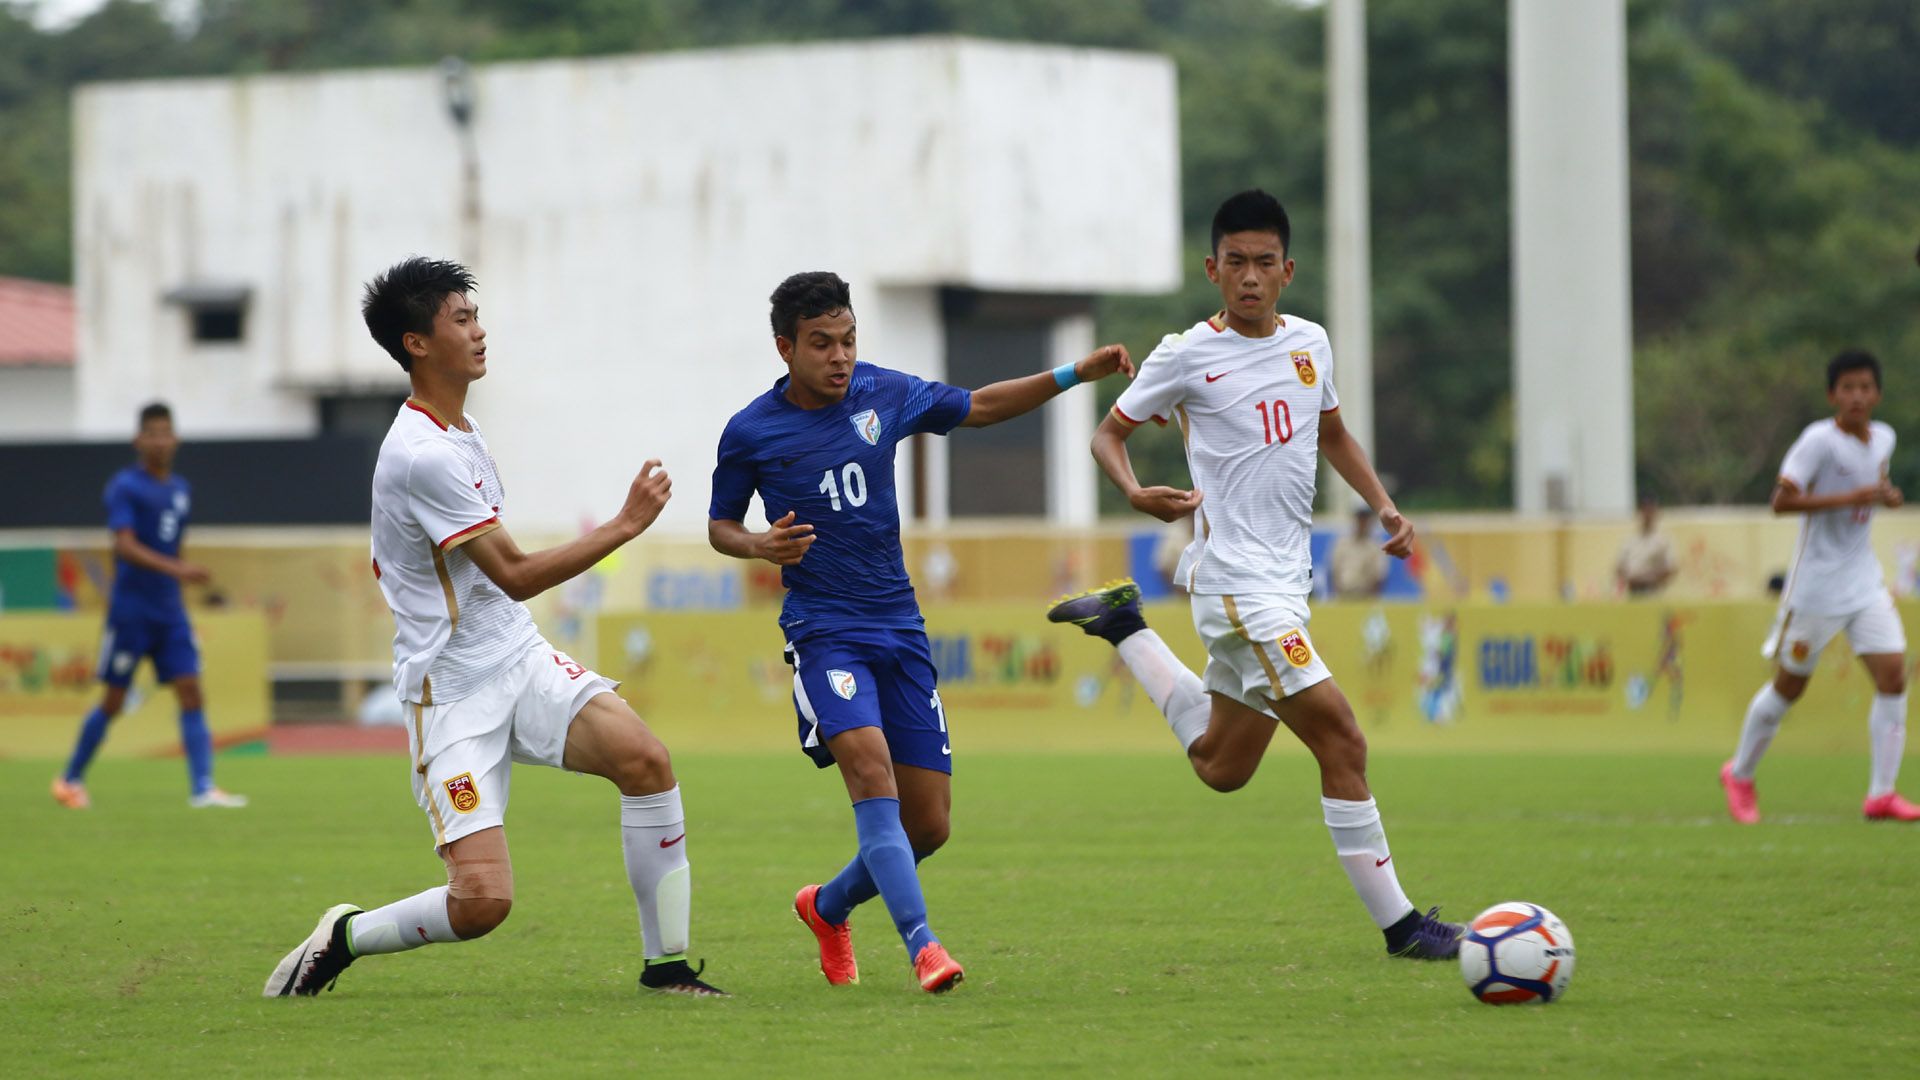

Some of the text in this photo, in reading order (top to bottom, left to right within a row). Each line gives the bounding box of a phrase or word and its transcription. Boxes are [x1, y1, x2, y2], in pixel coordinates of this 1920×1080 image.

[1255, 399, 1293, 445] 10
[819, 462, 868, 512] 10
[1280, 633, 1300, 647] CFA
[447, 776, 470, 790] CFA
